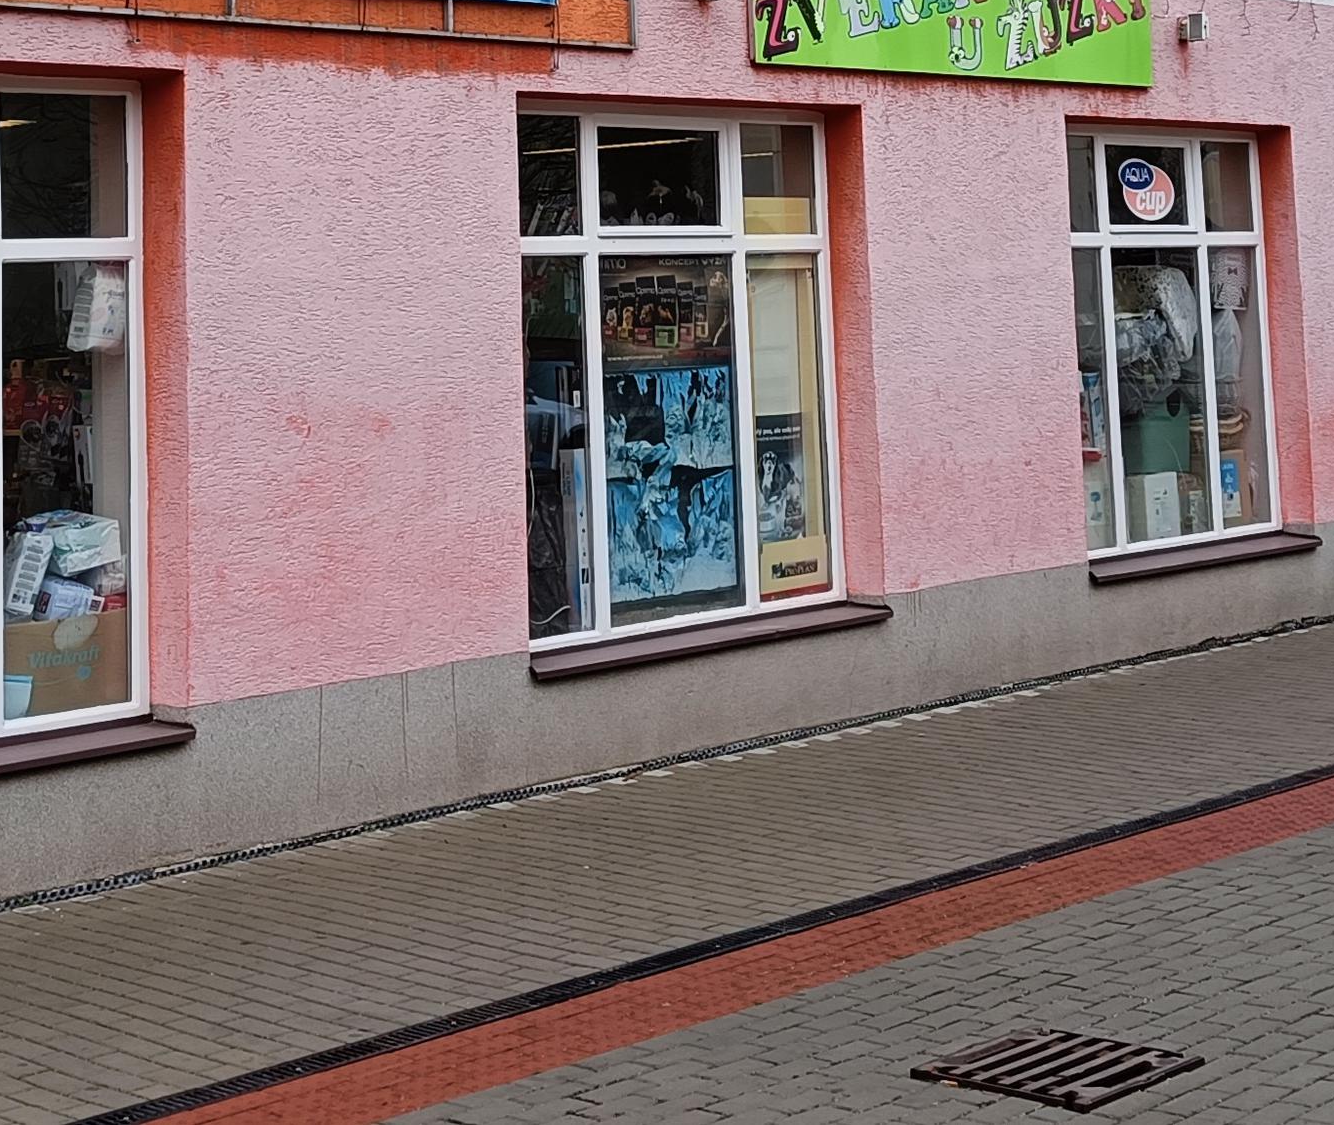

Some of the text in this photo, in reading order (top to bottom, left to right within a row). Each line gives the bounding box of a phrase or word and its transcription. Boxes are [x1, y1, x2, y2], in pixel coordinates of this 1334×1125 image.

[946, 15, 984, 71] U
[1124, 166, 1151, 183] AQUA
[1135, 191, 1166, 215] cup
